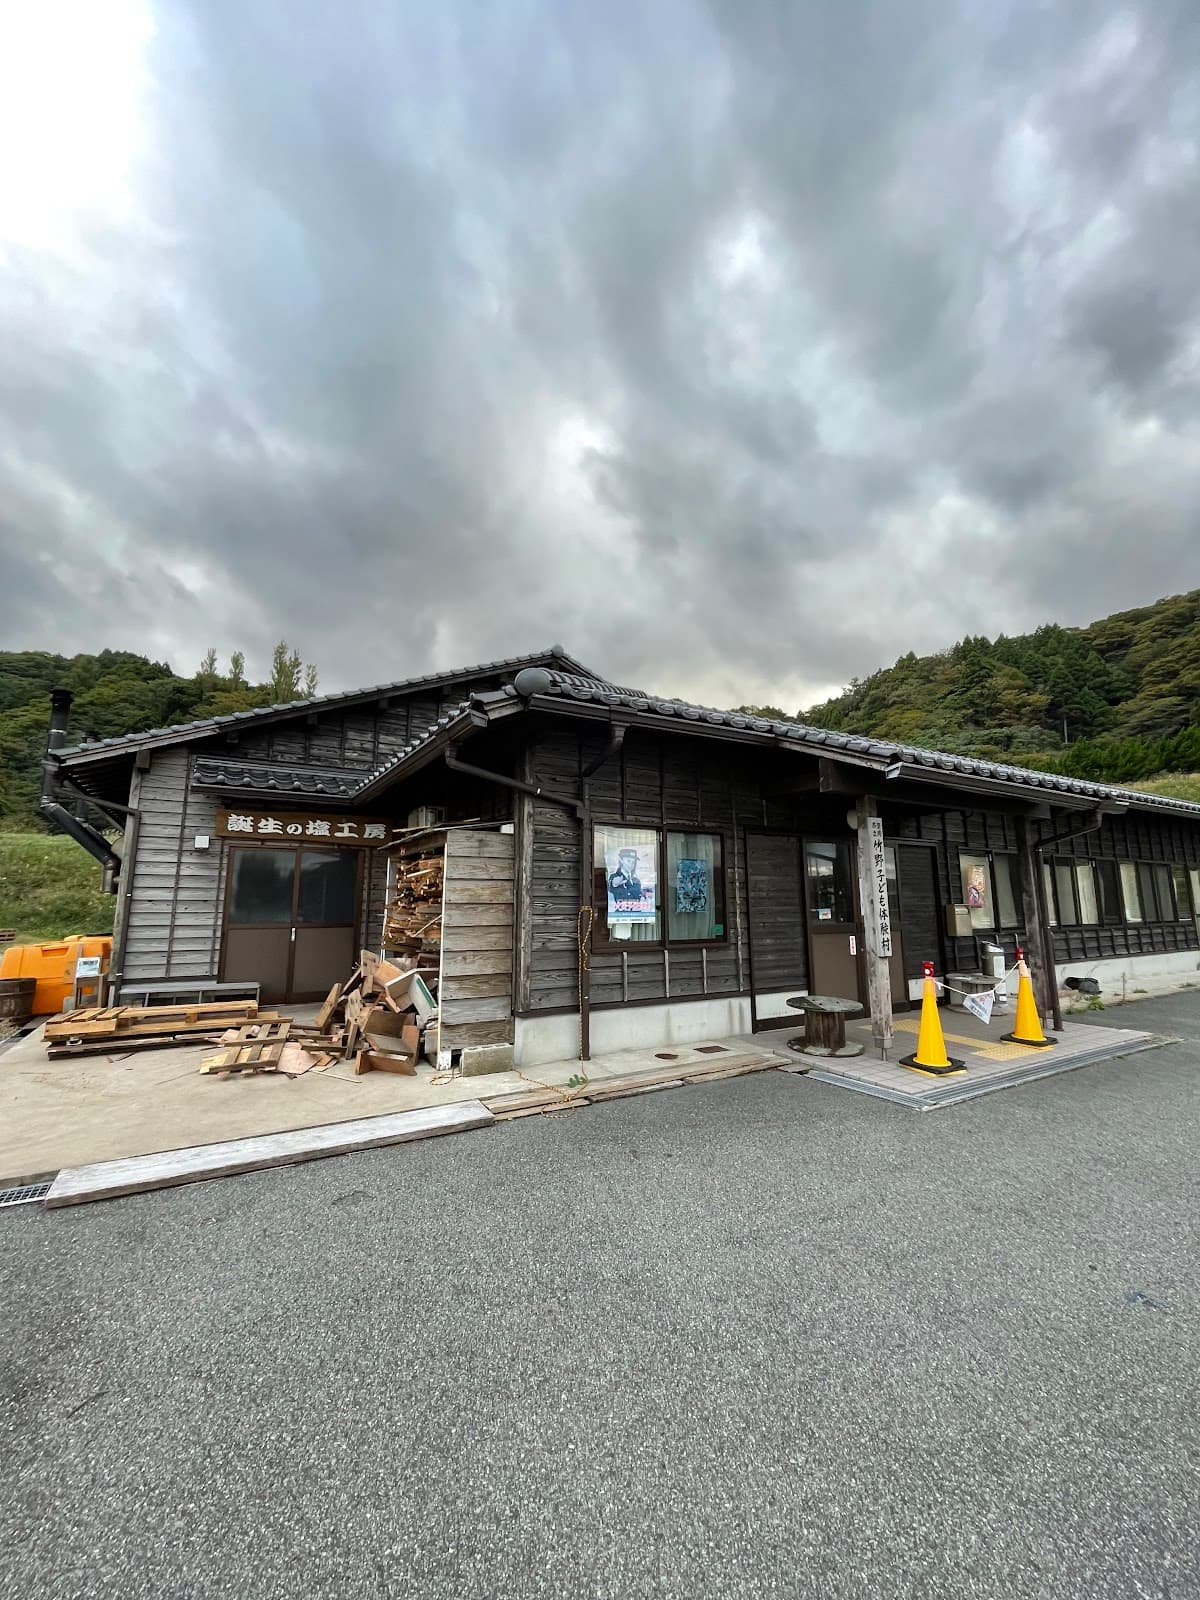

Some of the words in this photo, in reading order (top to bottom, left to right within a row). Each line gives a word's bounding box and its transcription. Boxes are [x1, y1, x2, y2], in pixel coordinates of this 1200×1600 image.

[228, 814, 386, 839] 誕生の塩工房
